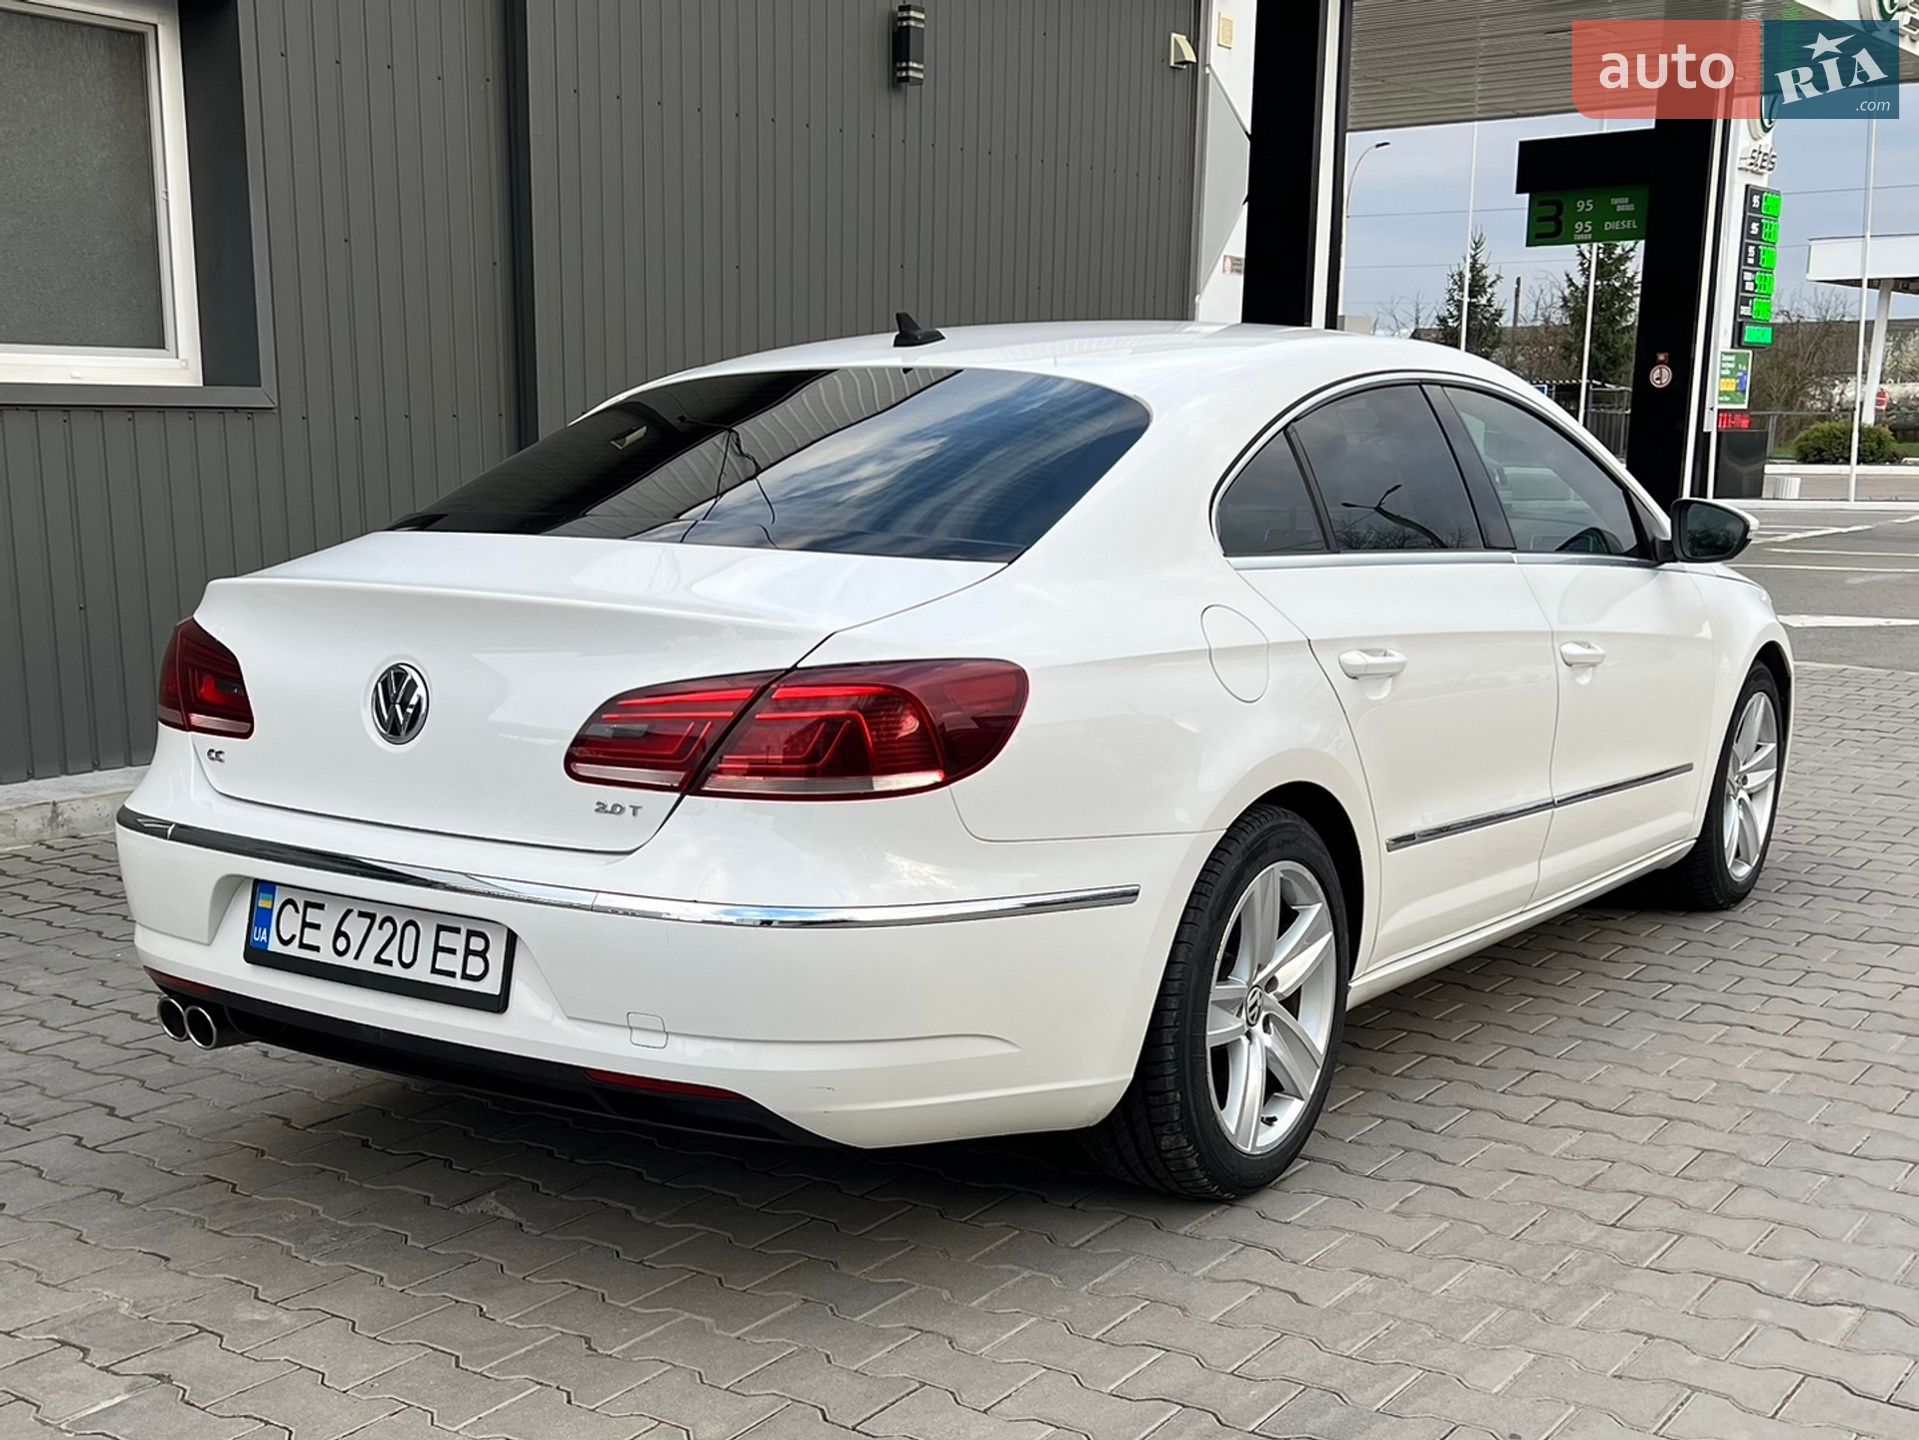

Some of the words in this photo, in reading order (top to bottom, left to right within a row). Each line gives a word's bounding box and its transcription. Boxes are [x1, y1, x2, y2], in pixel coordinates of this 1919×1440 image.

[1576, 199, 1594, 212] 95
[1534, 198, 1564, 240] 3
[1604, 219, 1638, 231] DIESEL
[1574, 221, 1593, 233] 95
[207, 748, 225, 763] CC
[628, 804, 643, 817] T
[254, 926, 268, 943] UA
[275, 897, 326, 953] CE
[331, 907, 422, 970] 6720
[430, 923, 491, 983] EB
